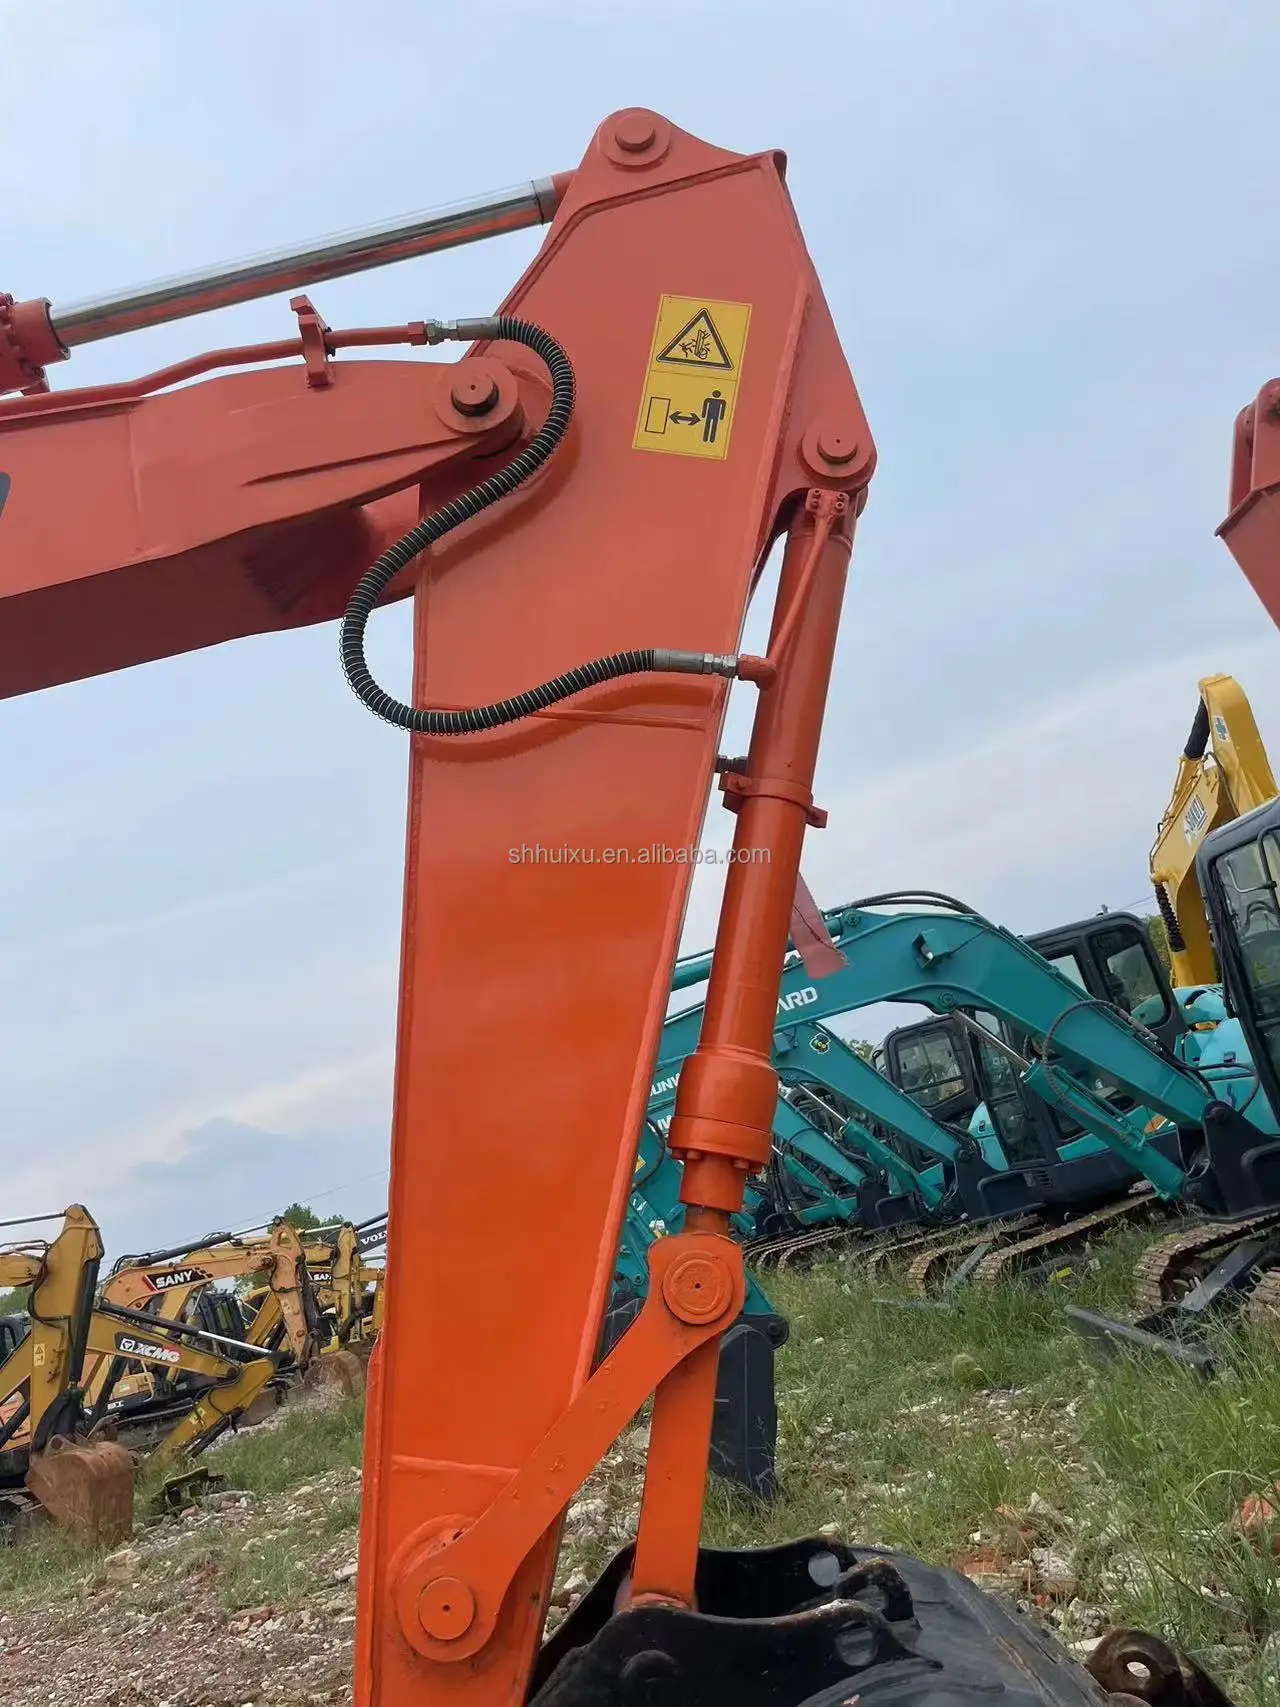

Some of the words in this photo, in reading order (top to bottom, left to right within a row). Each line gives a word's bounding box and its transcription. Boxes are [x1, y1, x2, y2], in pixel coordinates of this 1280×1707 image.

[360, 1230, 387, 1245] VOL
[155, 1270, 193, 1289] SANY
[133, 1342, 180, 1363] XCMG
